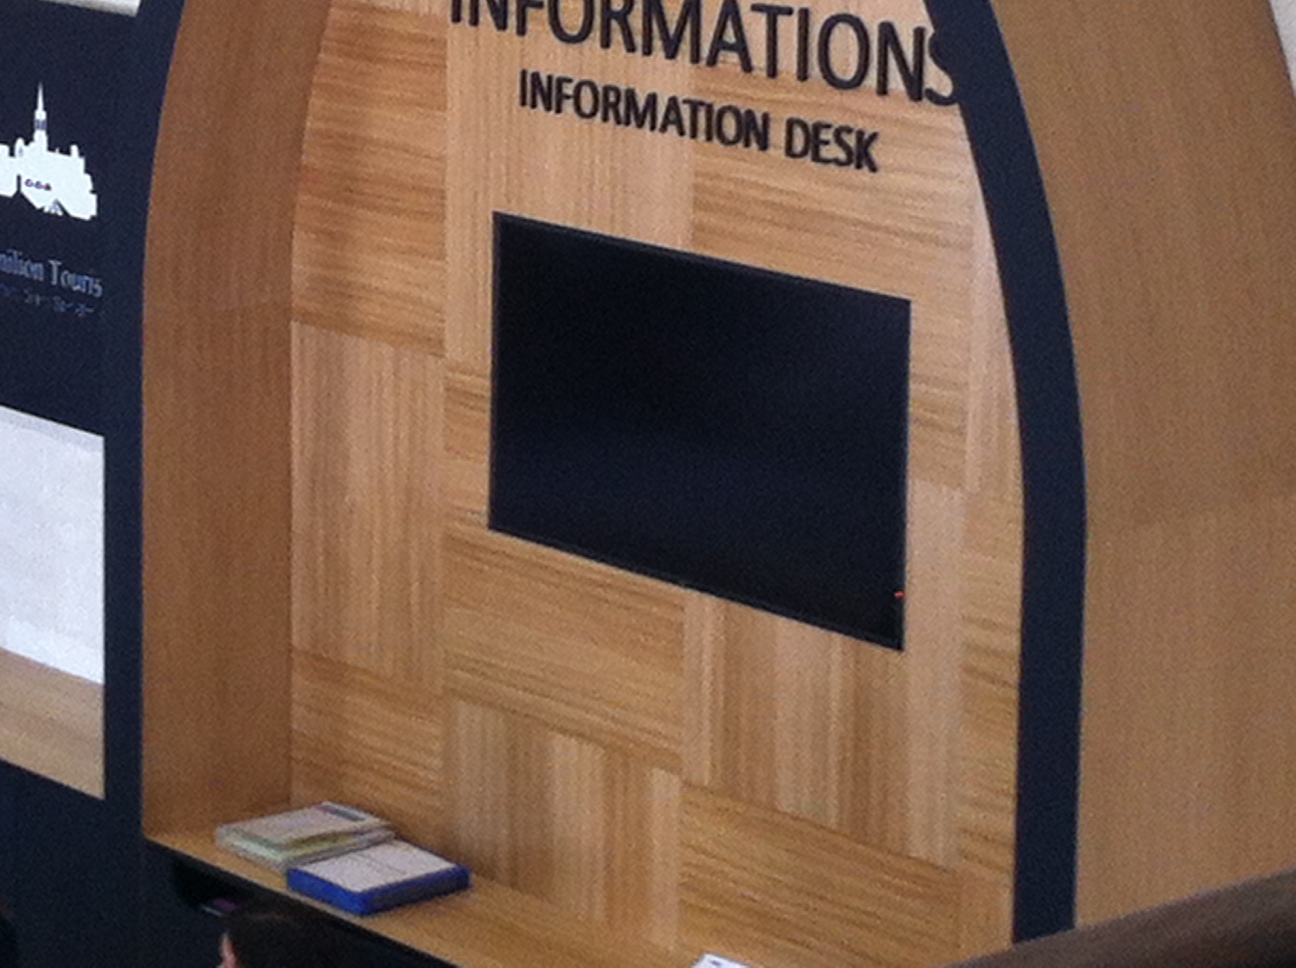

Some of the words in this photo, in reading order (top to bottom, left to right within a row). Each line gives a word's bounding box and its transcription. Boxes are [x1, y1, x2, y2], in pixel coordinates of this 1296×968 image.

[518, 68, 771, 153] INFORMATION
[784, 116, 880, 174] DESK
[48, 259, 103, 298] Tours
